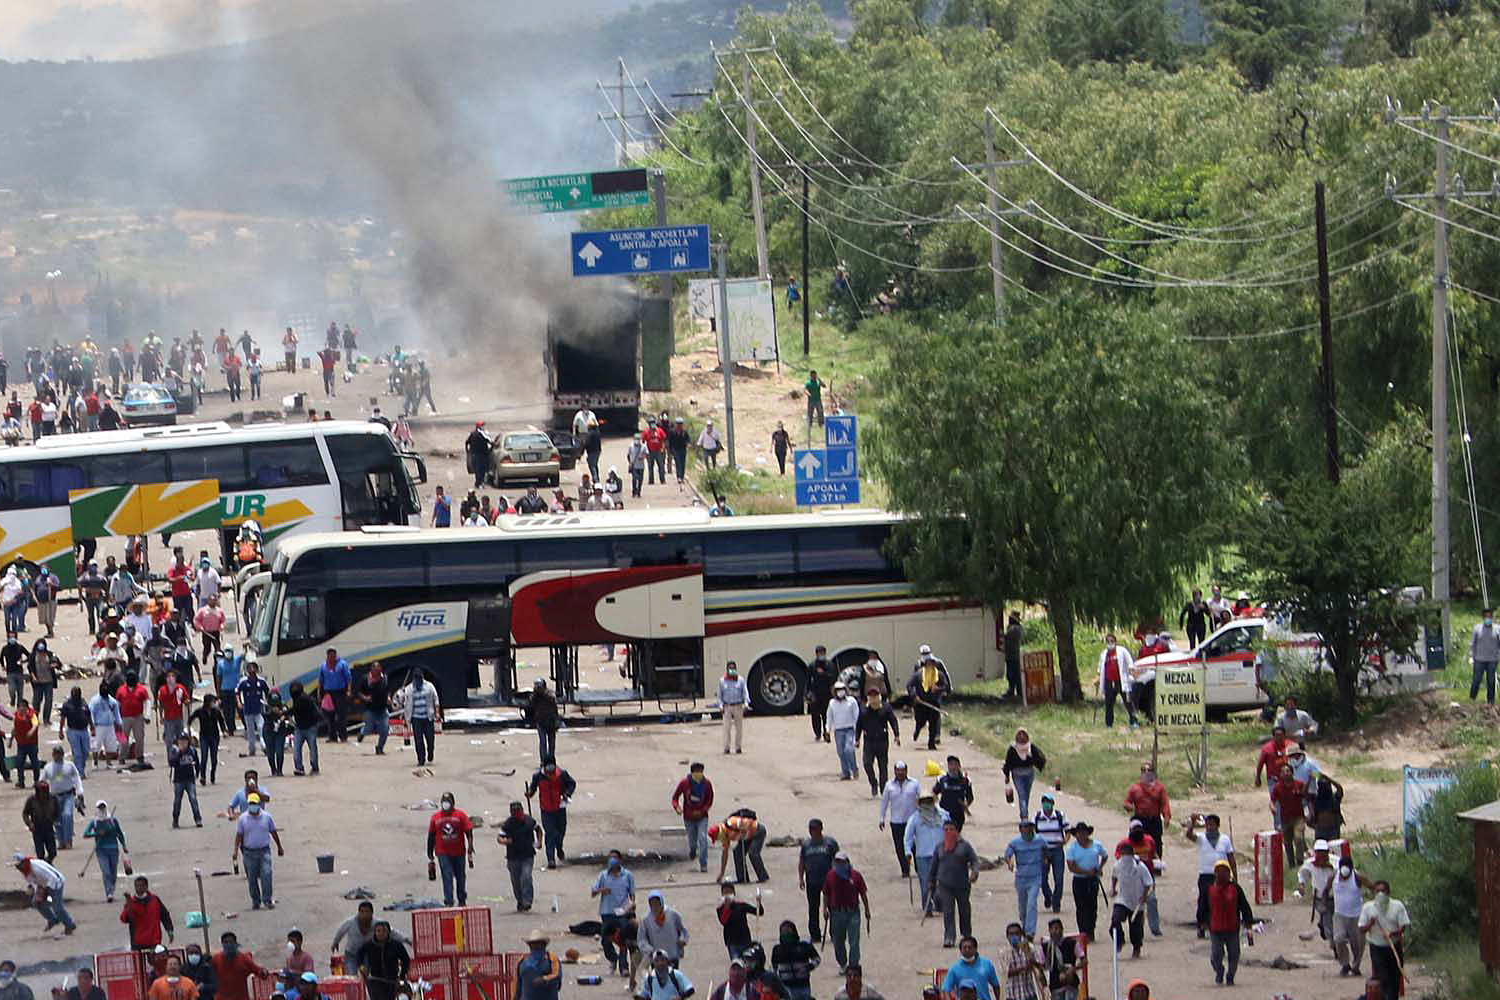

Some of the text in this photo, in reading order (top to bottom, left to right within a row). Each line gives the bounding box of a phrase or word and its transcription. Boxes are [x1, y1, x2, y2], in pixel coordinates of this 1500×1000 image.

[651, 229, 699, 240] NOCHIXTLAN
[807, 482, 848, 493] APOALA
[1164, 672, 1196, 685] MEZCAL
[1160, 694, 1200, 705] Y CREMAS
[1158, 713, 1202, 726] DE MEZCAL
